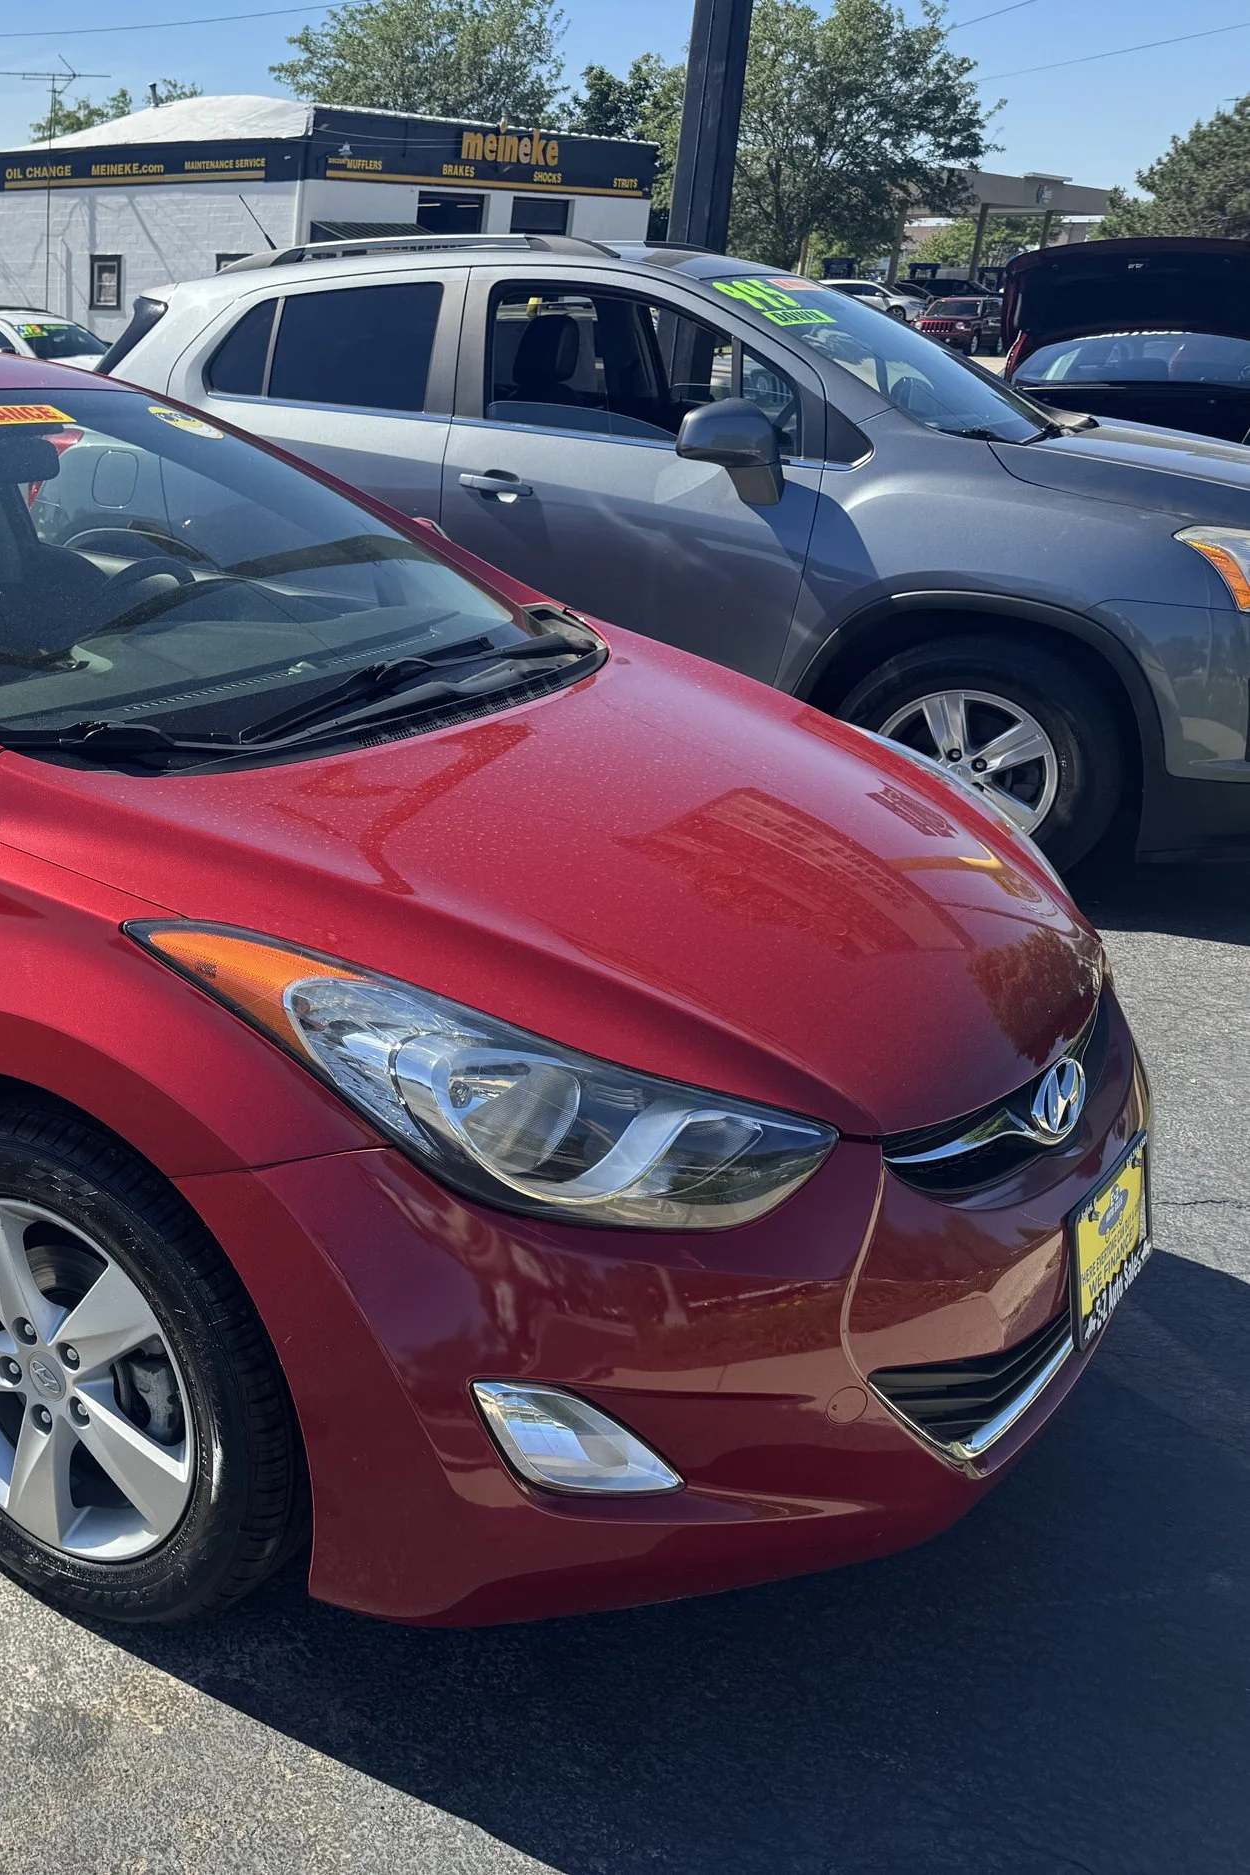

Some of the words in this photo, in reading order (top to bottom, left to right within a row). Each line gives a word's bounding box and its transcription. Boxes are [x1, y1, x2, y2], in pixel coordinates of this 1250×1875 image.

[461, 118, 559, 166] meineke
[91, 163, 165, 176] MEINEKE.com
[184, 159, 234, 170] MAINTENANCE
[235, 158, 266, 168] SERVICE
[347, 159, 383, 171] MUFFLERS
[442, 164, 475, 178] BRAKES
[5, 168, 23, 180] OIL
[26, 165, 72, 178] CHANGE
[533, 171, 562, 183] SHOCKS
[613, 177, 638, 188] STRUTS
[770, 309, 827, 323] DOWN
[1124, 1251, 1141, 1290] Sales
[1088, 1271, 1102, 1297] WE
